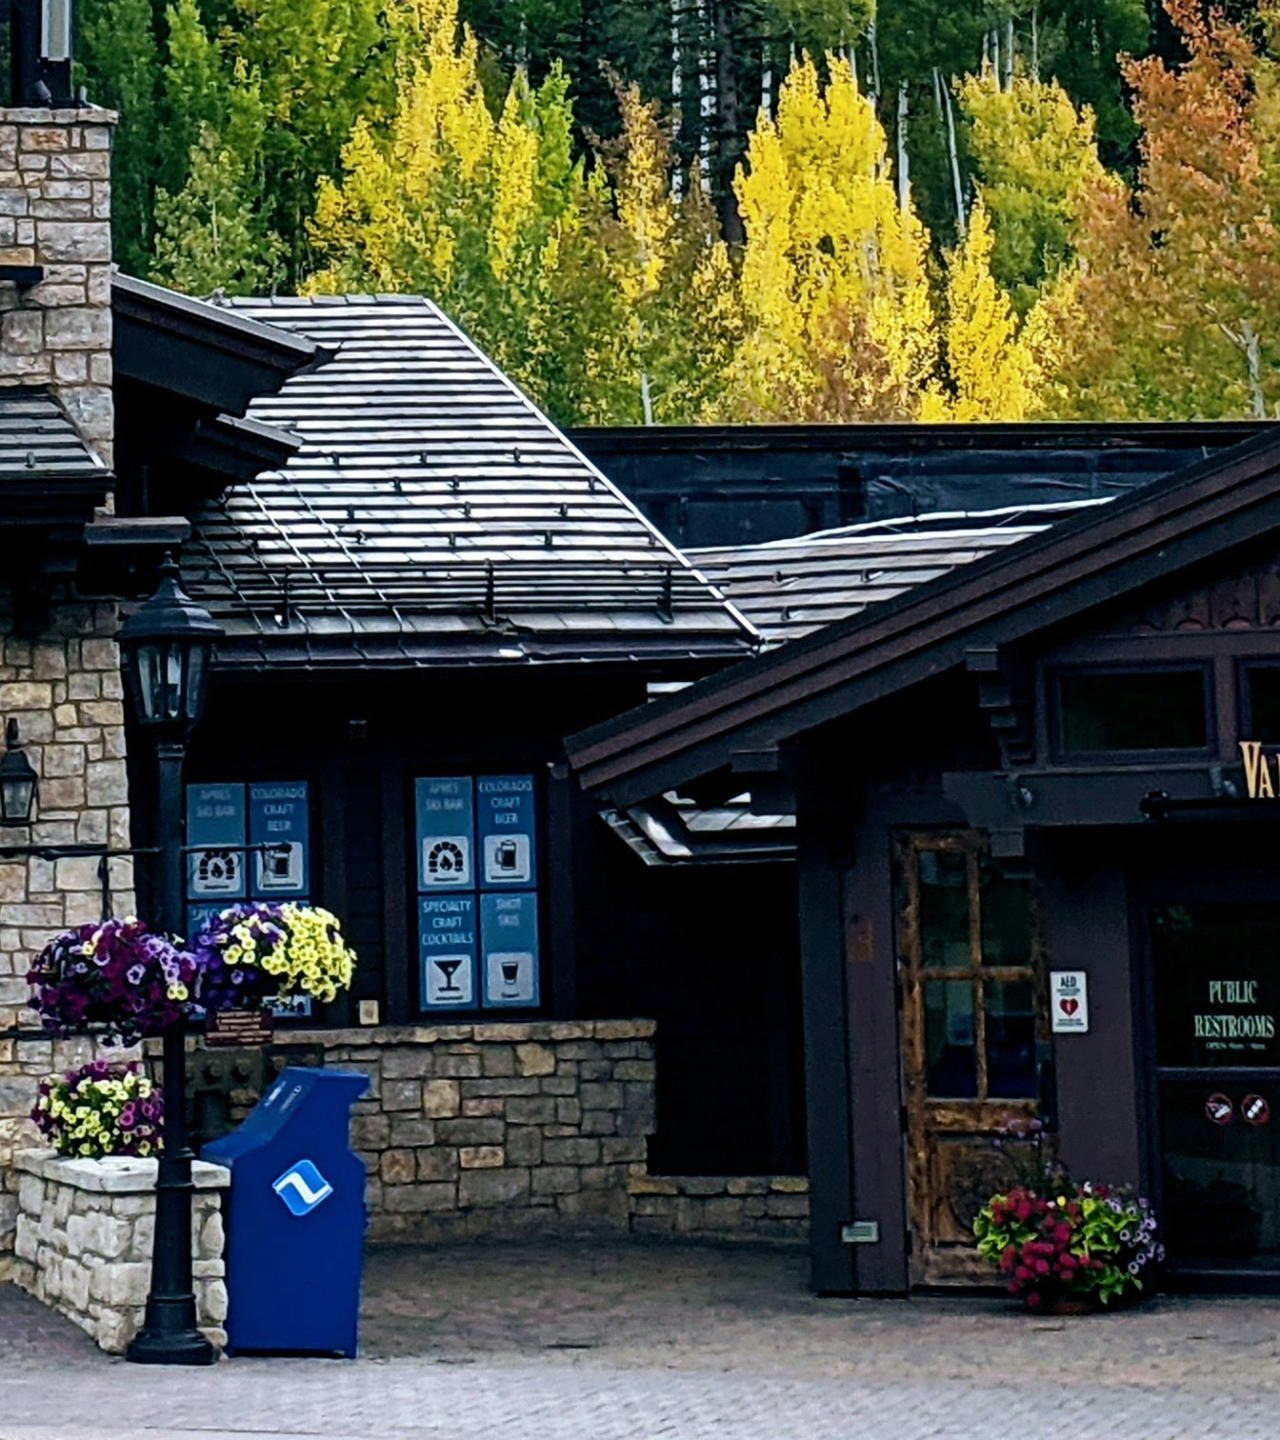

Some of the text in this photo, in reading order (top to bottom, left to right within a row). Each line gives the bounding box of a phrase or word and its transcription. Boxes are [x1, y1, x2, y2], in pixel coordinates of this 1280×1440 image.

[251, 787, 306, 800] COLORADO
[479, 781, 532, 793] COLORADO
[423, 900, 472, 913] SPECIALTY
[432, 916, 462, 929] CRAFT
[422, 932, 474, 946] COCKTAILS
[1208, 980, 1258, 1004] PUBLIC
[1194, 1014, 1275, 1038] RESTROOMS
